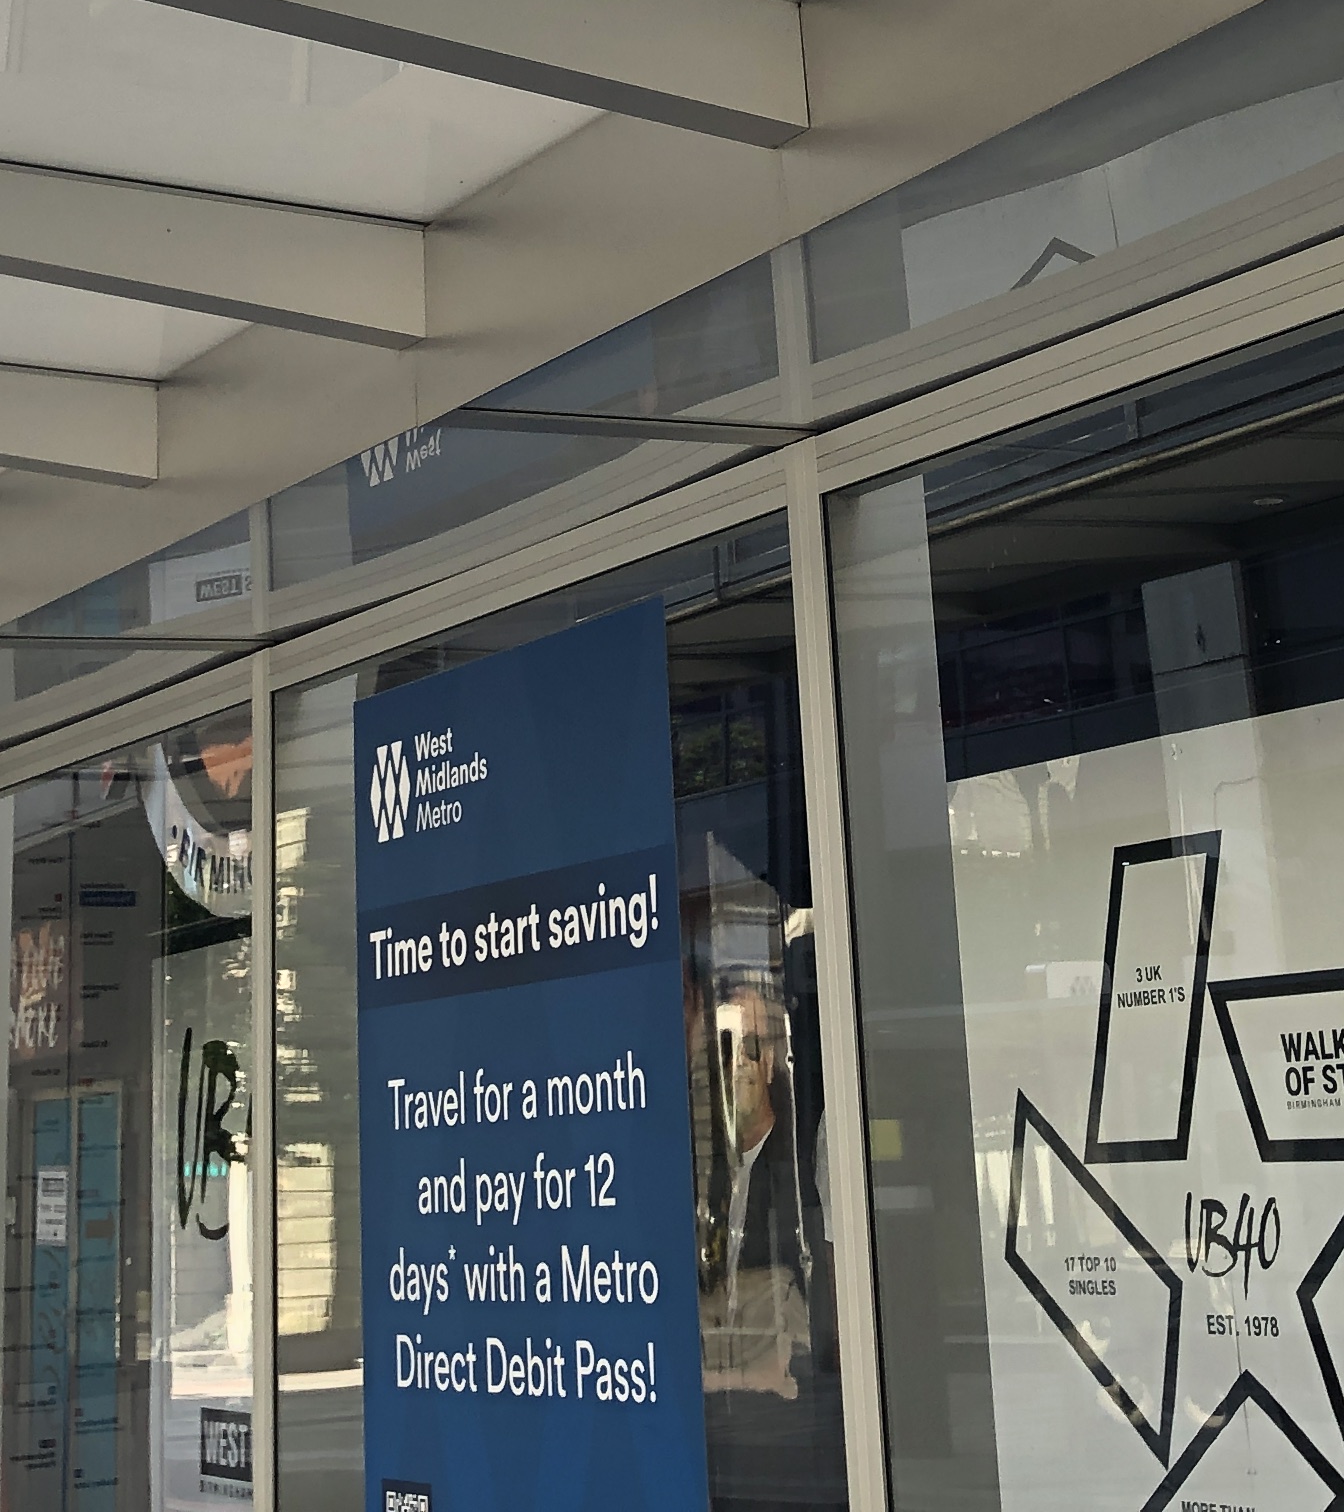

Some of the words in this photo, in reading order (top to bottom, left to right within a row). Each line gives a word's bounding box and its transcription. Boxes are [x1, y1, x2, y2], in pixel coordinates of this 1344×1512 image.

[414, 727, 453, 762] West
[415, 751, 488, 798] Midlands
[415, 800, 462, 833] Metro
[369, 926, 433, 980] Time
[439, 921, 467, 968] to
[474, 903, 541, 962] start
[548, 873, 659, 950] saving!
[1136, 968, 1143, 982] 3
[1145, 965, 1162, 982] UK
[1117, 988, 1166, 1008] NUMBER
[387, 1071, 466, 1130] Travel
[474, 1068, 513, 1124] for
[522, 1079, 538, 1120] a
[547, 1050, 646, 1117] month
[1285, 1066, 1315, 1096] OF
[1286, 1098, 1342, 1110] BIRMINGHAM
[418, 1157, 466, 1215] and
[476, 1169, 526, 1226] pay
[534, 1151, 576, 1210] for
[584, 1152, 616, 1208] 12
[1185, 1192, 1281, 1300] UB40
[464, 1245, 526, 1303] with
[536, 1262, 551, 1303] a
[561, 1244, 659, 1305] Metro
[1064, 1257, 1075, 1272] 17
[1078, 1256, 1101, 1272] TOP
[1104, 1256, 1116, 1272] 10
[1069, 1280, 1116, 1296] SINGLES
[1206, 1314, 1239, 1336] EST.
[1244, 1316, 1279, 1337] 1978
[395, 1334, 477, 1392] Direct
[485, 1337, 566, 1398] Debit
[576, 1339, 657, 1403] Pass!
